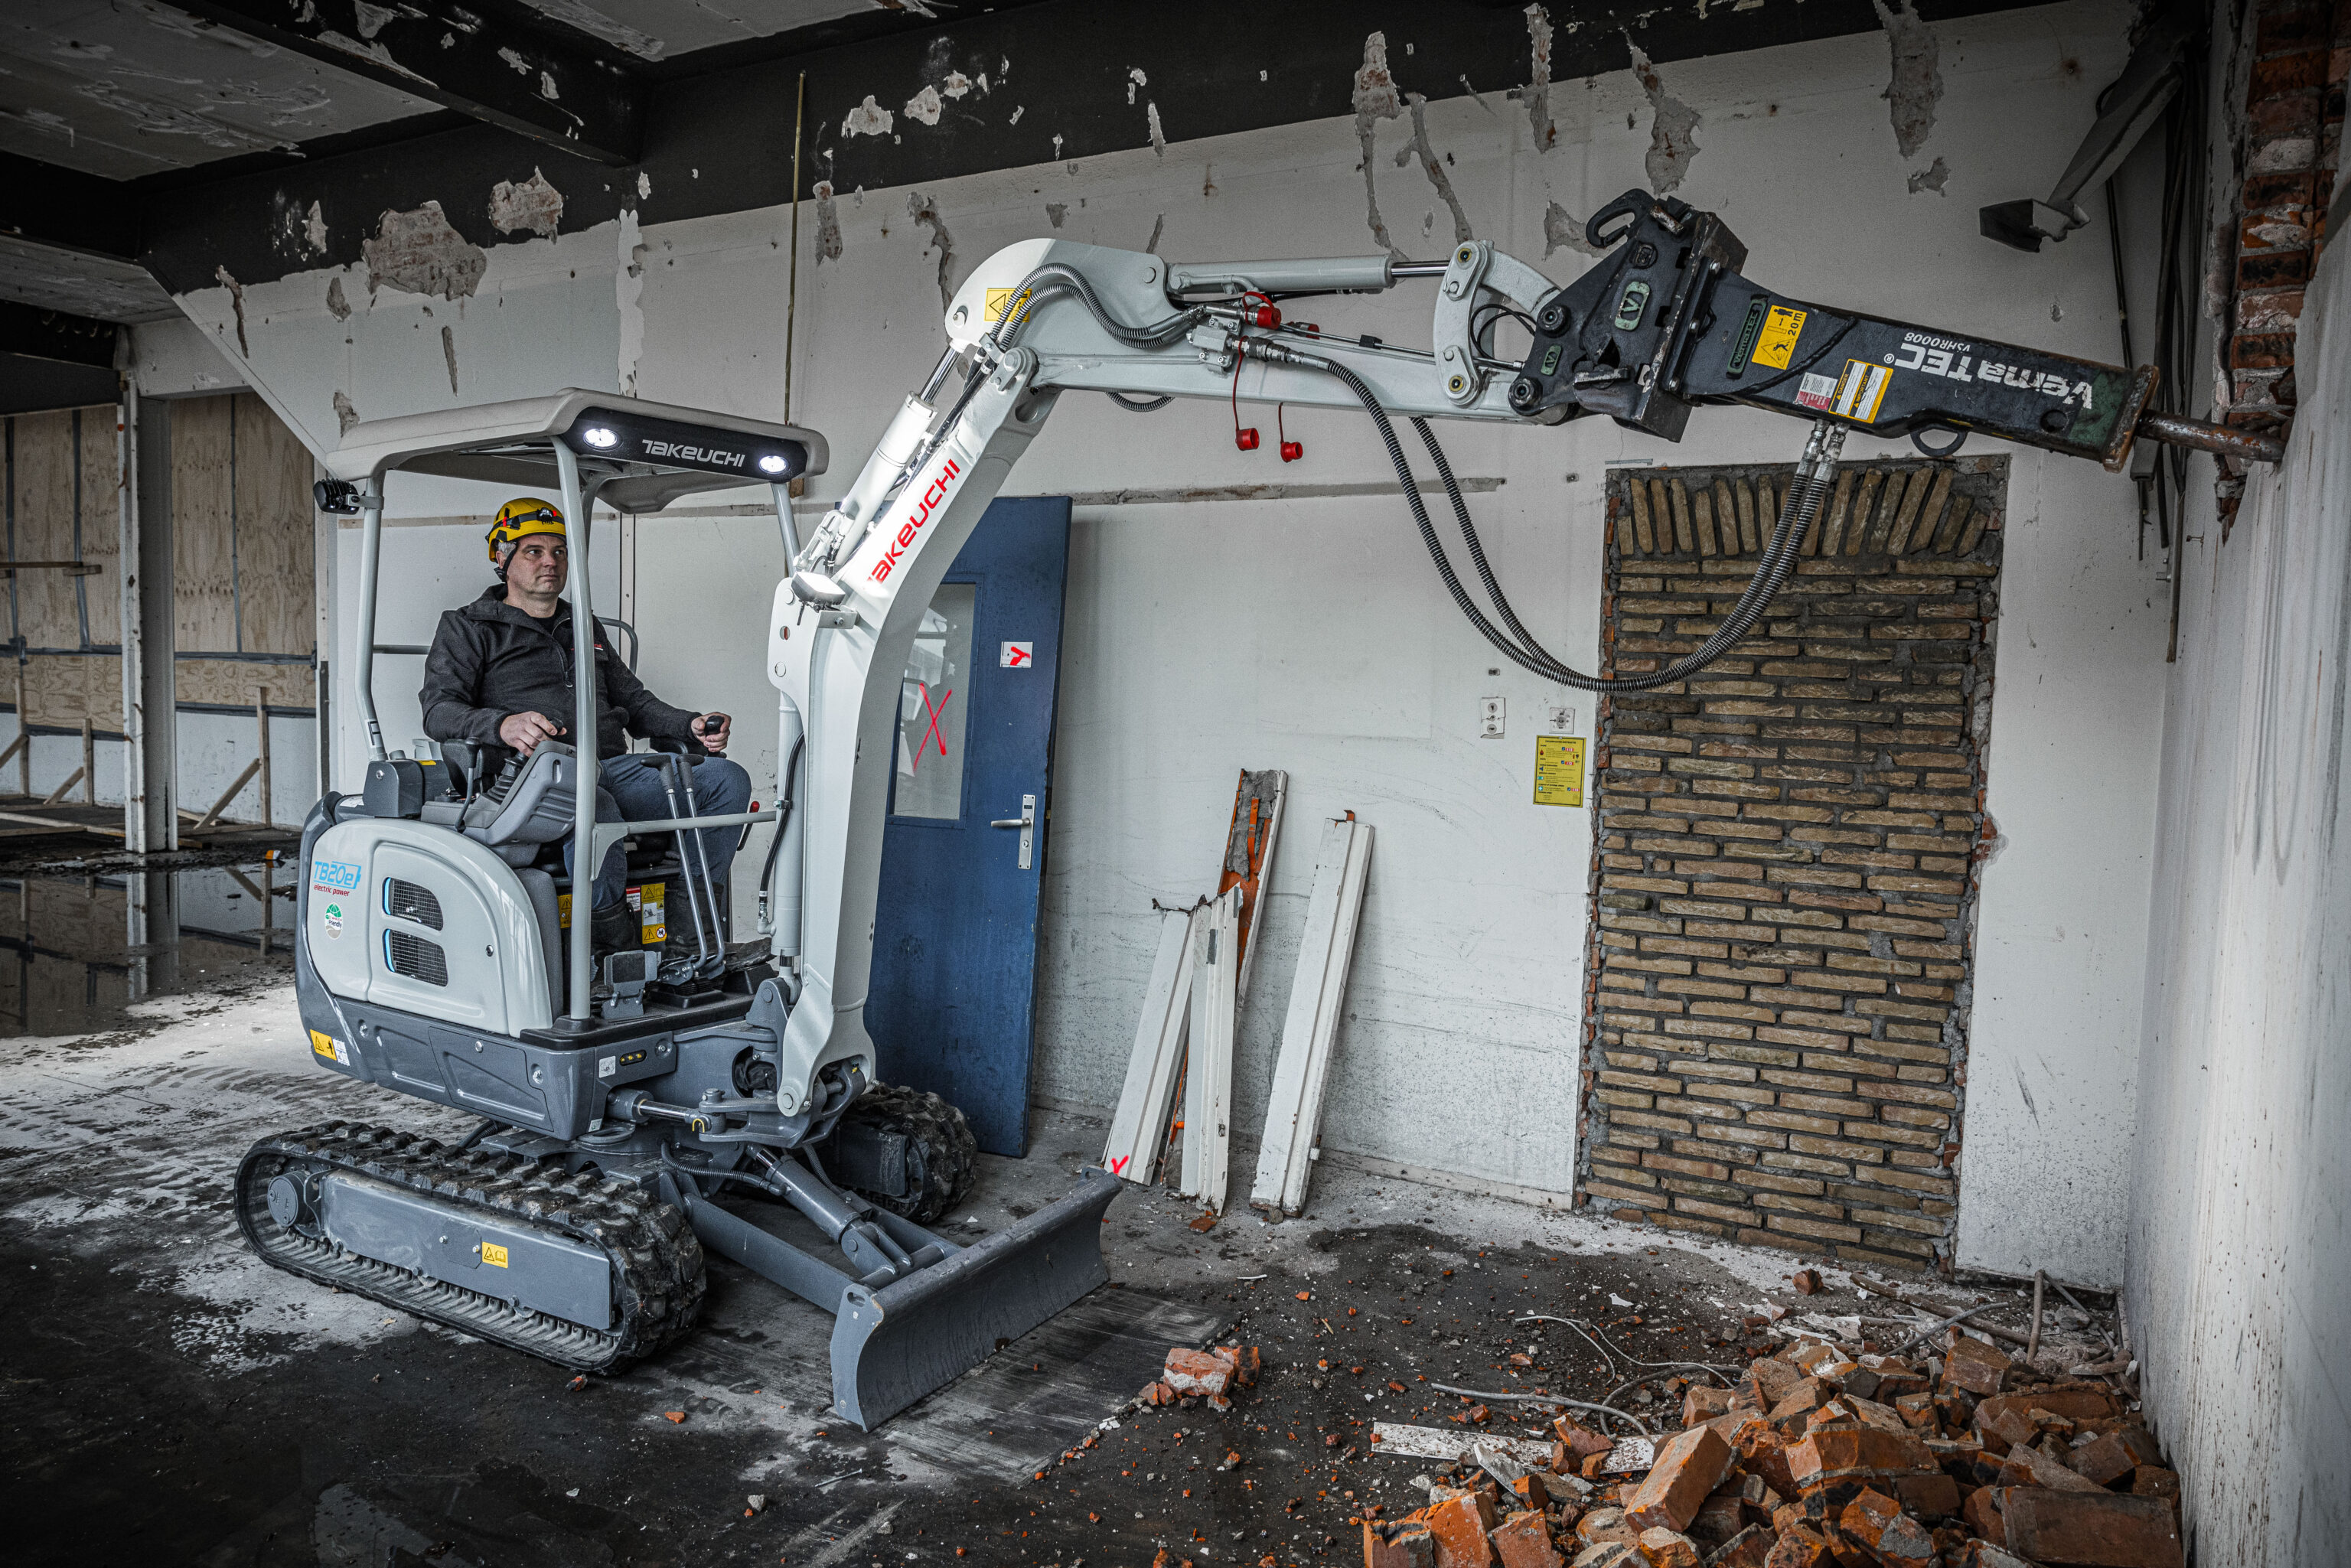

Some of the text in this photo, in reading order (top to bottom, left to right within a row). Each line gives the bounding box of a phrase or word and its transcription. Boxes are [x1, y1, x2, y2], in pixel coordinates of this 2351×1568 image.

[1904, 331, 1971, 353] VSHR0008
[1838, 373, 1850, 394] DANGER
[1856, 375, 1870, 403] IMPORTANT
[313, 861, 354, 886] TB20e
[314, 884, 350, 897] electric power
[328, 919, 342, 928] Friendly
